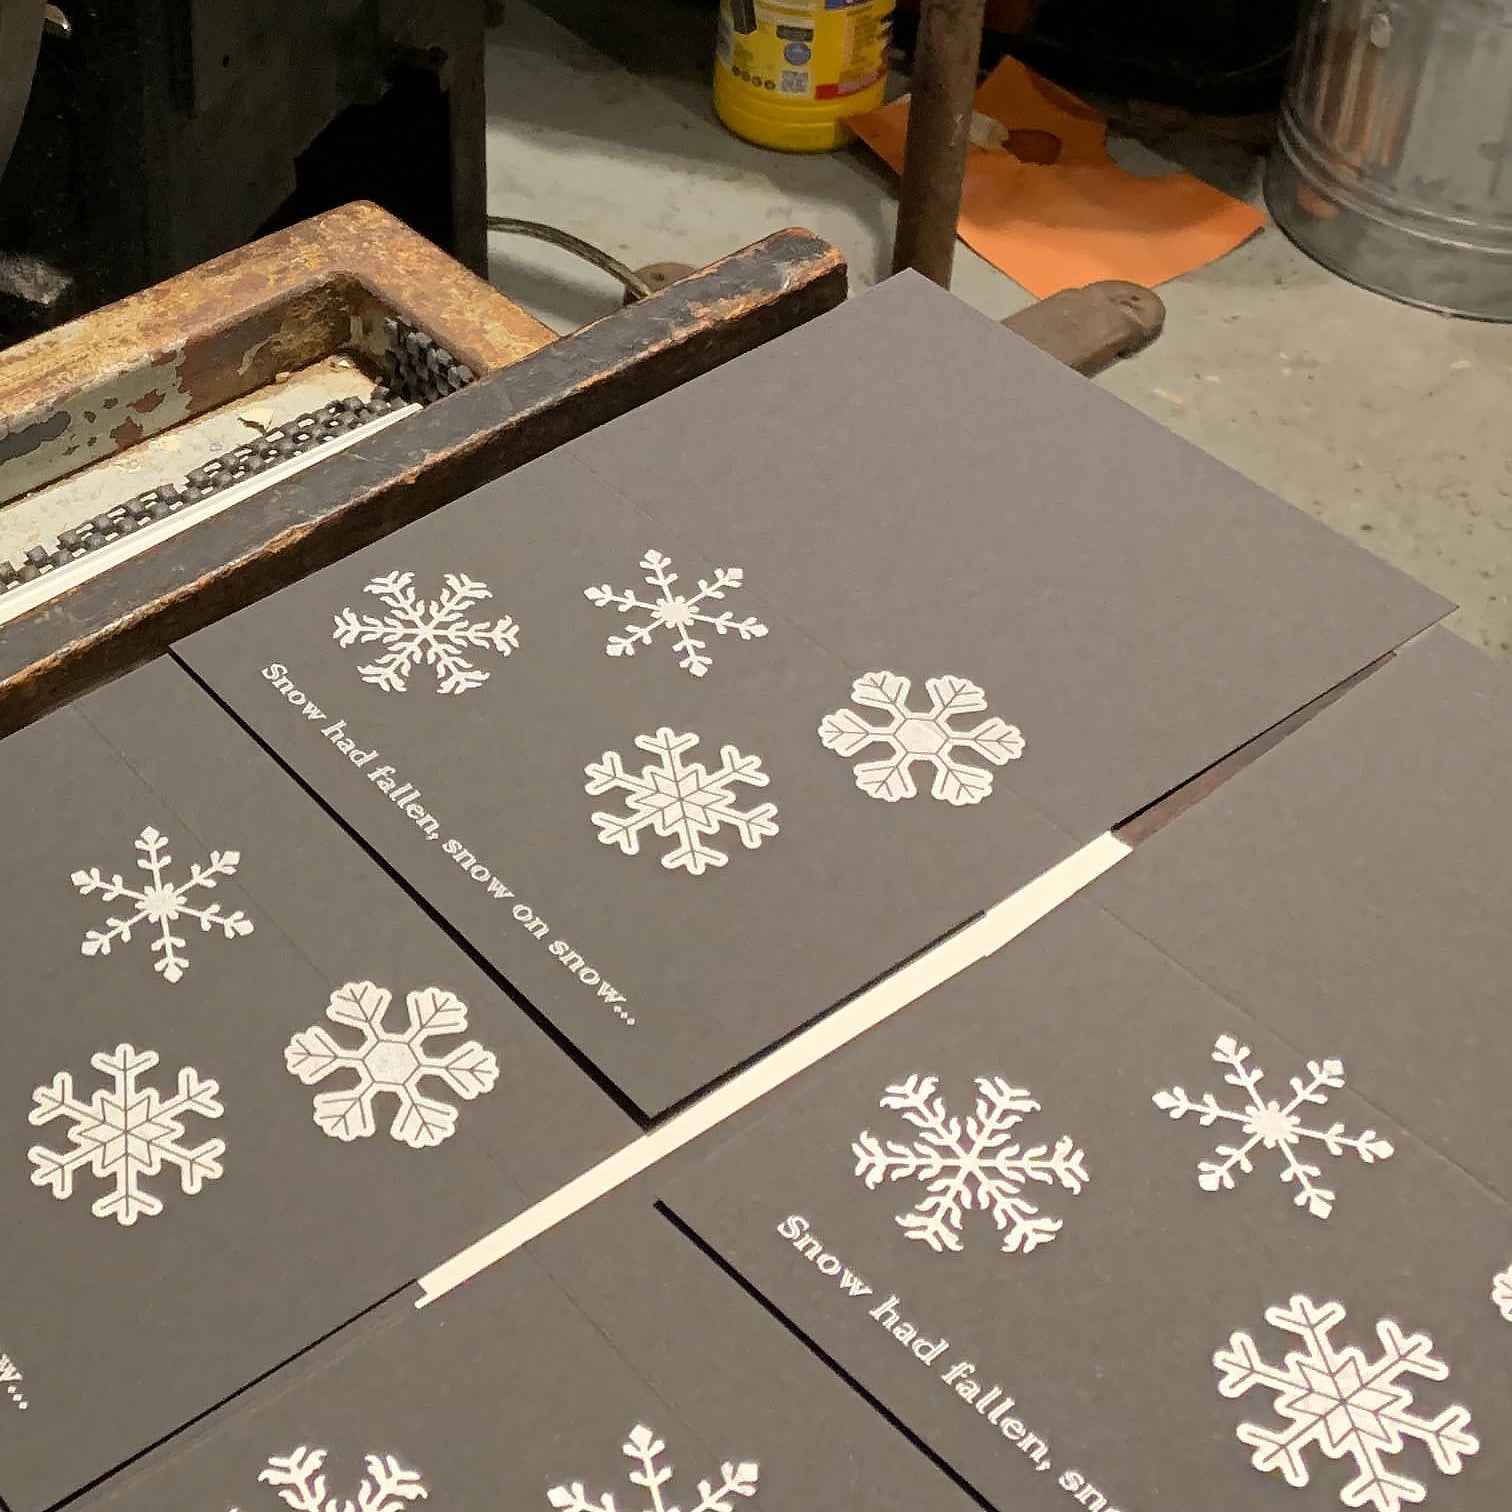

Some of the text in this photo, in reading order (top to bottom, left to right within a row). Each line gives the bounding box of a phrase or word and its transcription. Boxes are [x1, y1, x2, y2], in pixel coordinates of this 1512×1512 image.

[262, 663, 636, 1025] Snow had fallen, snow on snow...
[776, 1214, 1121, 1512] Snow had fallen, sn
